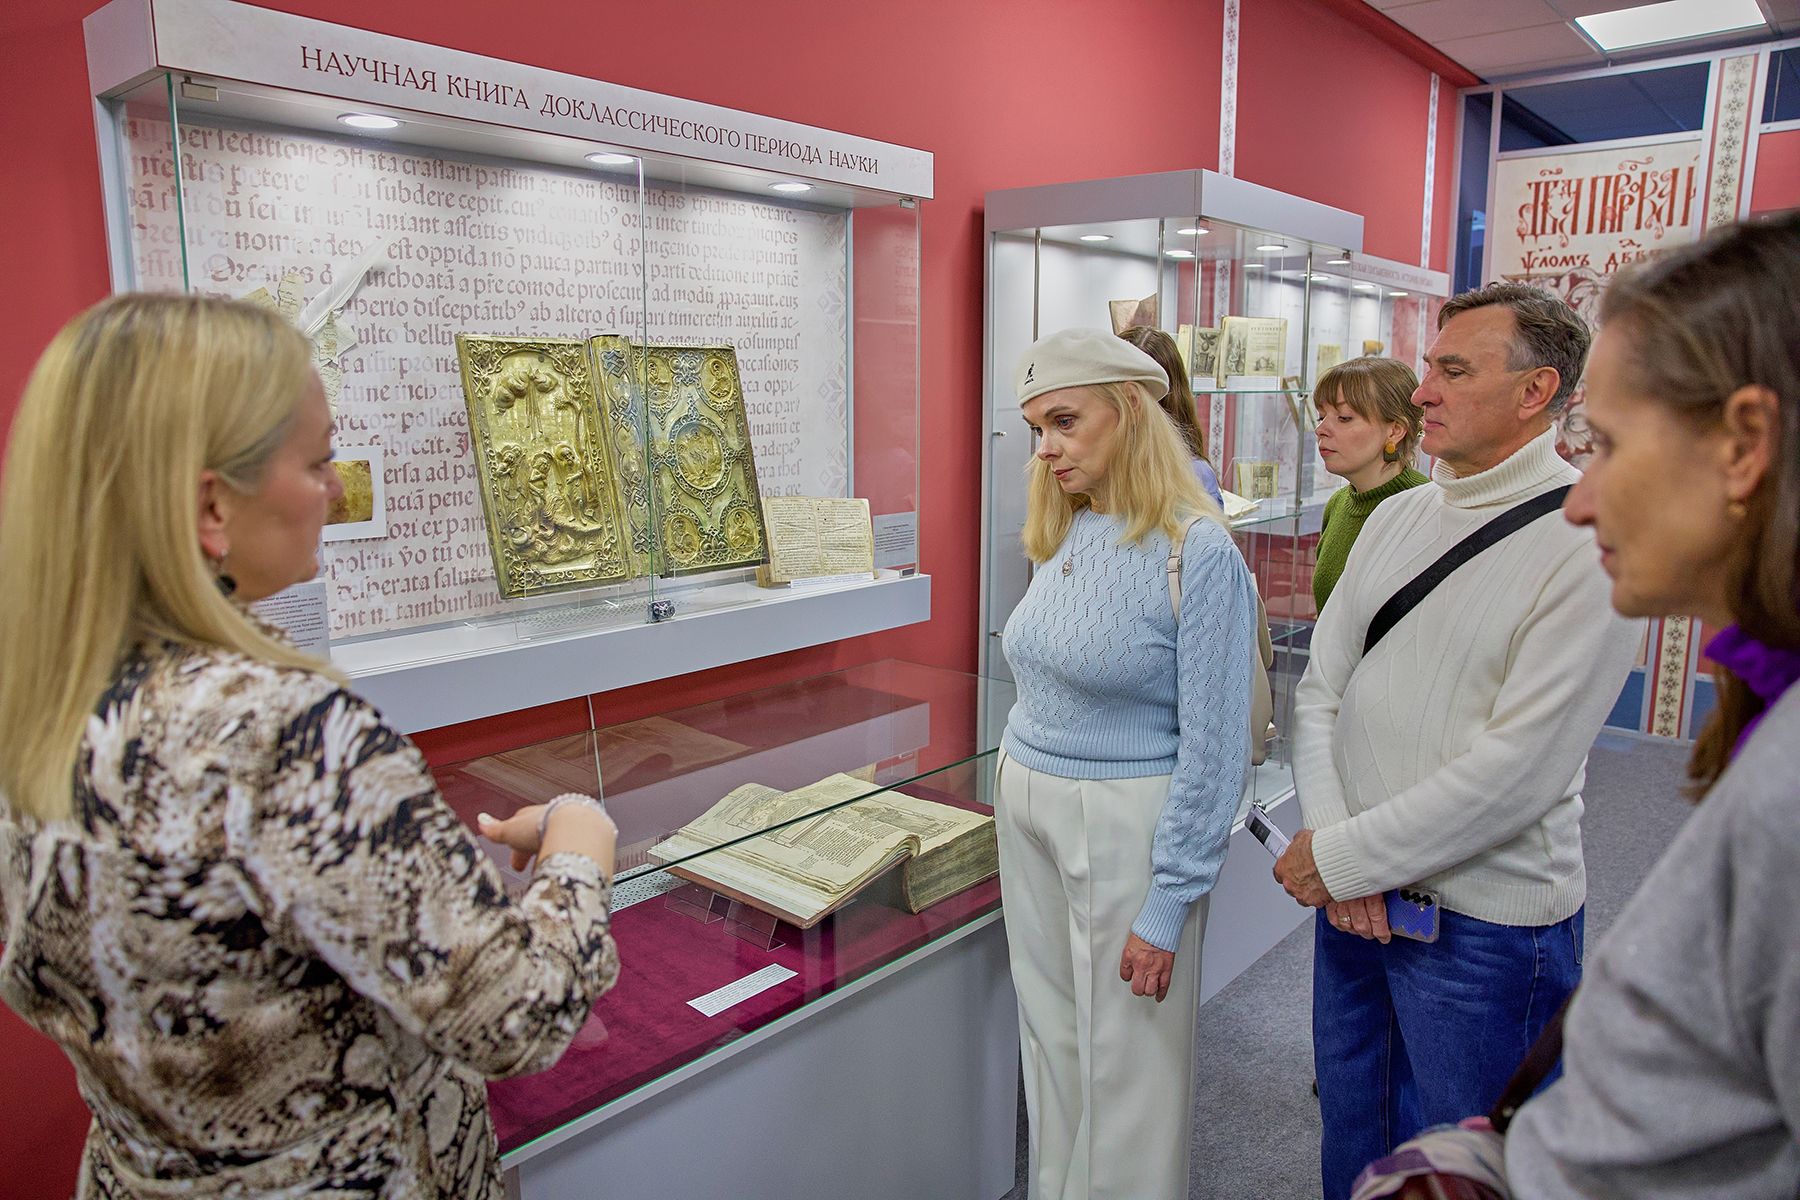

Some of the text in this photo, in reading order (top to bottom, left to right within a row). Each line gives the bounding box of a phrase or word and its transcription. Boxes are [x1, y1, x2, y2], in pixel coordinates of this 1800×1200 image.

[301, 45, 879, 175] НАУЧНАЯ КНИГА ДОКЛАССИЧЕСКОГО ПЕРИОДА НАУКИ
[425, 459, 450, 483] ad
